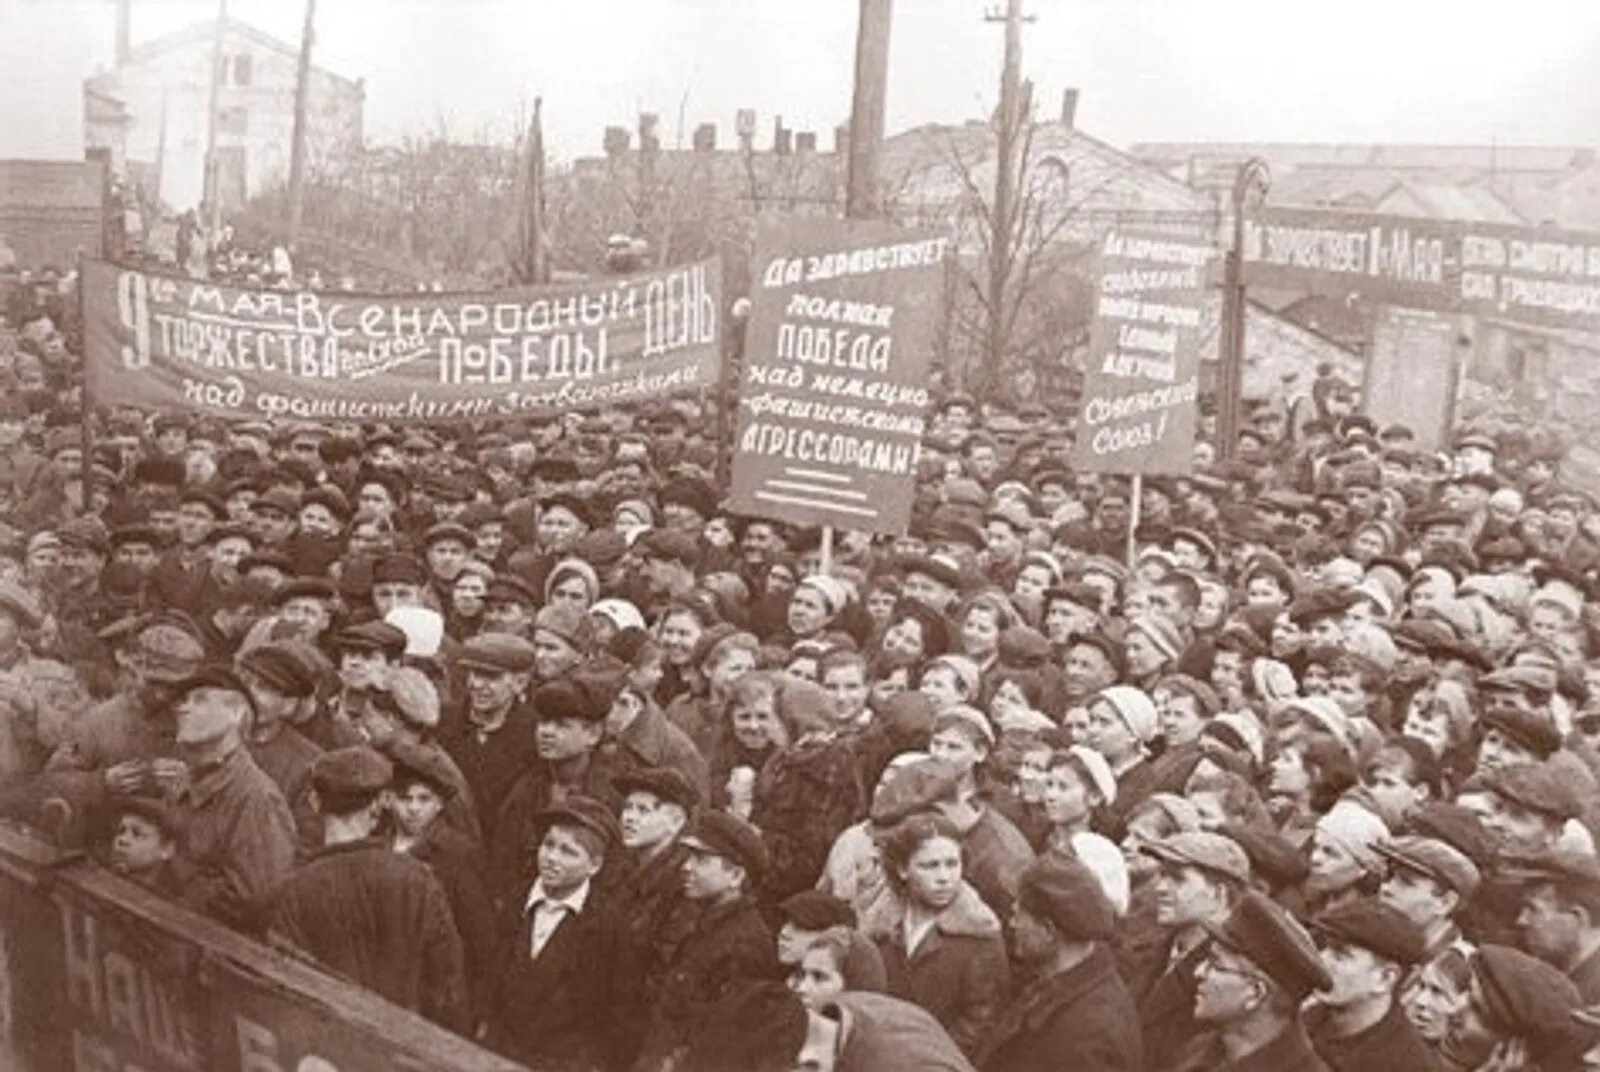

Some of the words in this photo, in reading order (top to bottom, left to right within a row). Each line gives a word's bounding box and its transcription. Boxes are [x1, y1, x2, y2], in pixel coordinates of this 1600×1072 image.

[643, 265, 716, 357] ДЕНЬ
[155, 314, 338, 378] ТОРЖЕСТВА
[777, 323, 892, 373] ПОБЕДА
[747, 364, 805, 388] над
